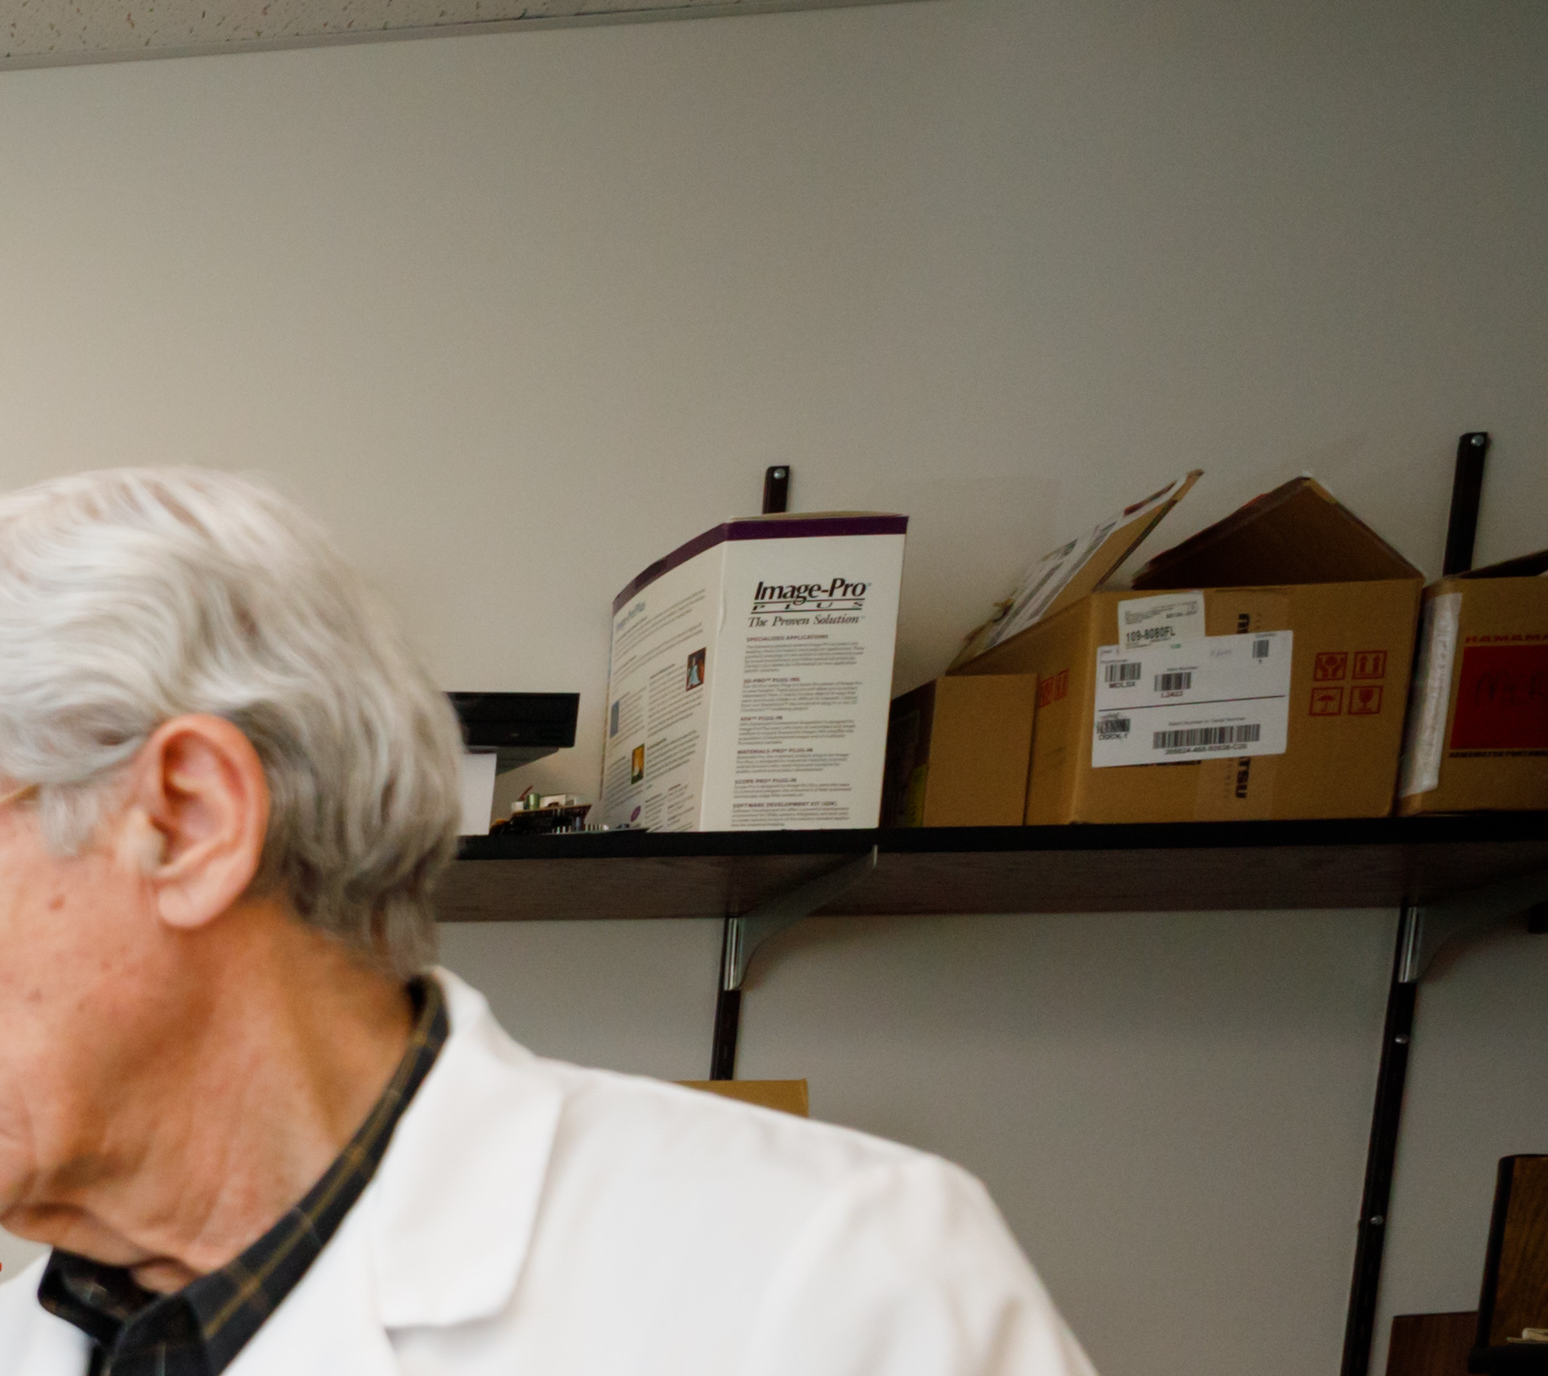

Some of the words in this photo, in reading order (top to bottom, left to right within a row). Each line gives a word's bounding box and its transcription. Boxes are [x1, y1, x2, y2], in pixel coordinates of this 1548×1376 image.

[754, 578, 867, 606] Image-Pro
[748, 616, 768, 628] The
[771, 616, 810, 627] Proven
[813, 613, 860, 625] Solution
